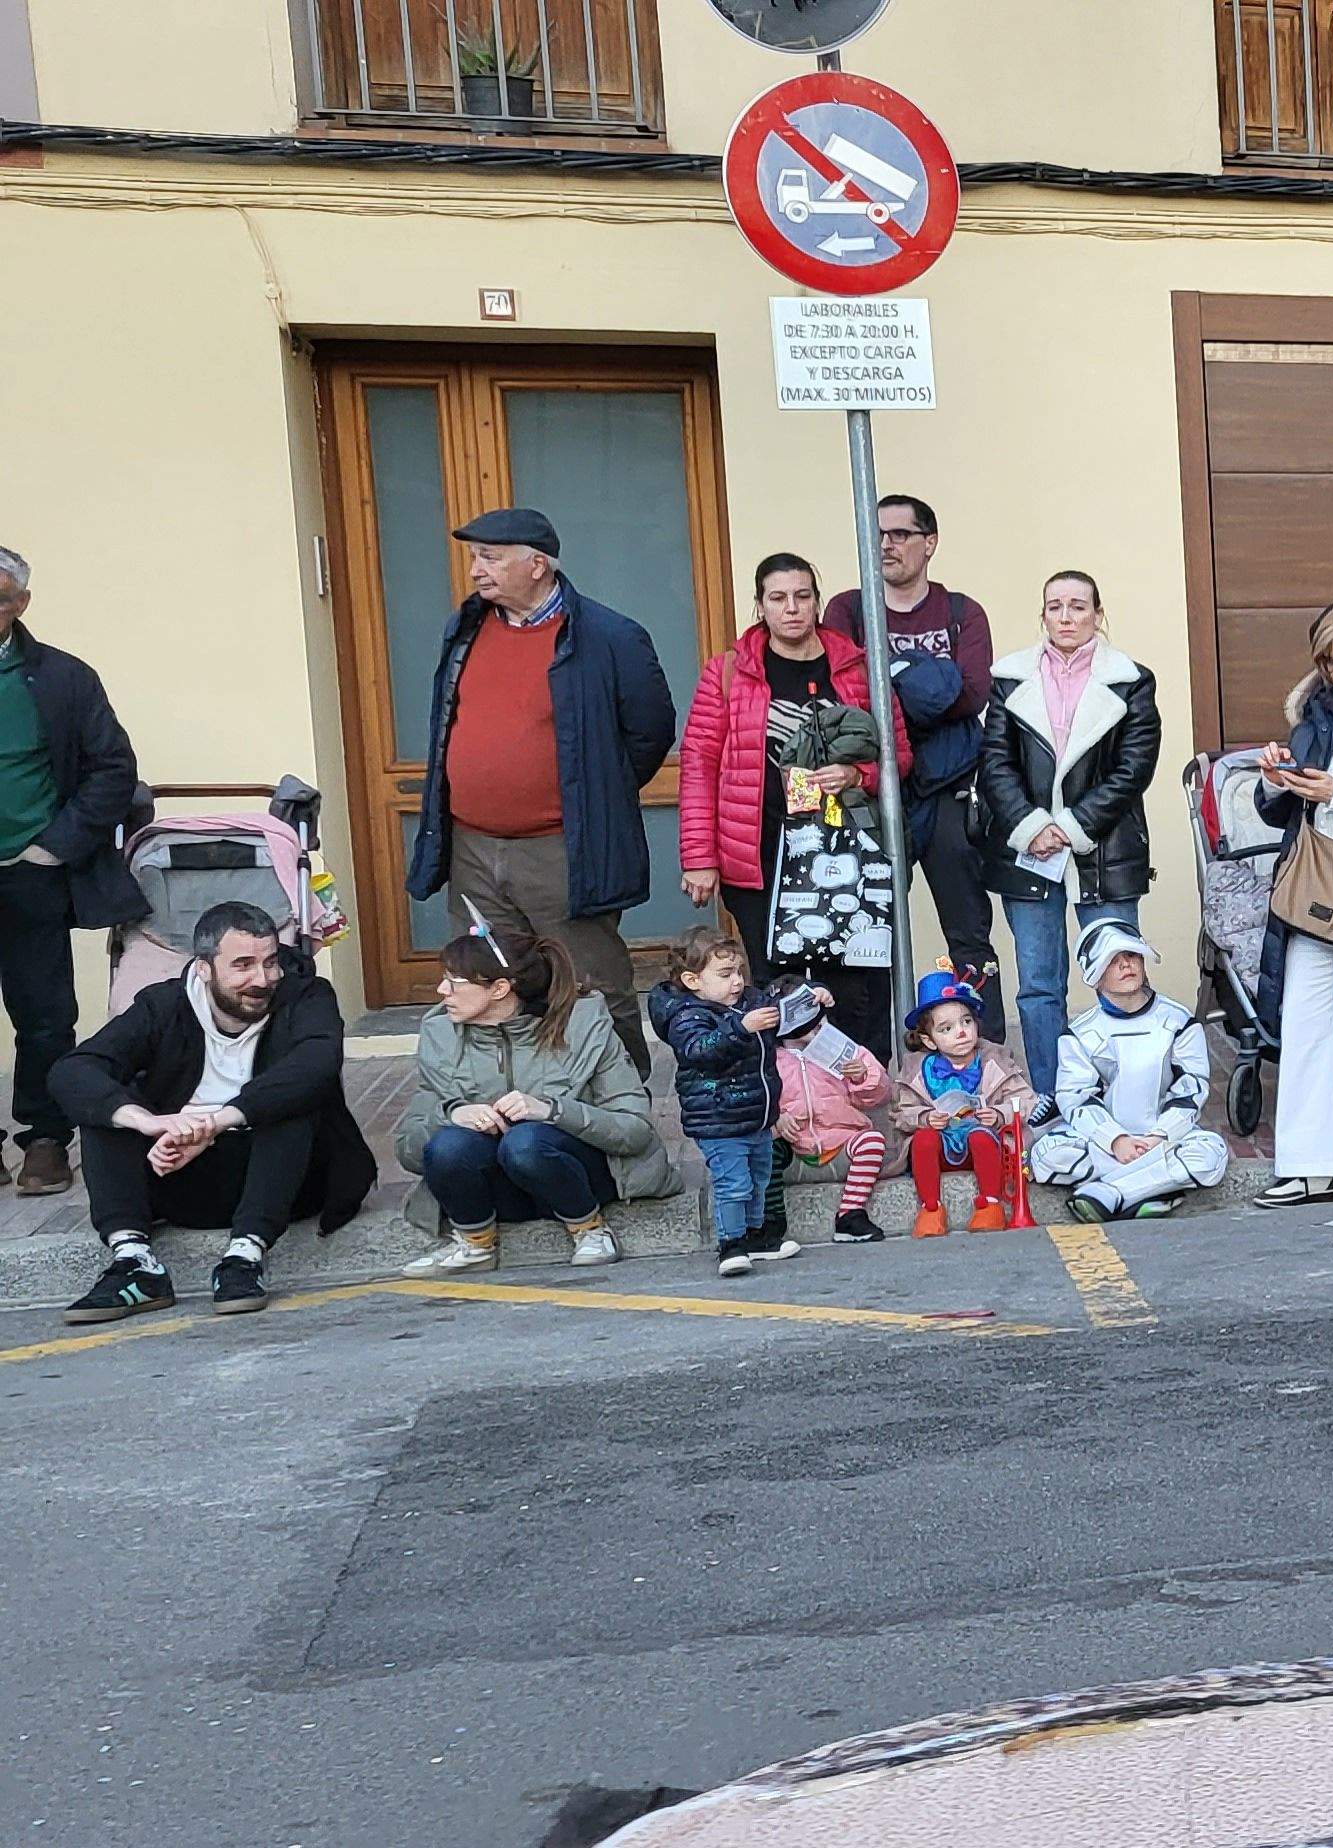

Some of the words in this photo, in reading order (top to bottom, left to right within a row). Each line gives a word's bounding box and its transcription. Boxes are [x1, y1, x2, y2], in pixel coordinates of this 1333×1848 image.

[799, 302, 900, 318] LABORABLES
[783, 323, 807, 339] DE
[844, 324, 858, 339] A
[860, 324, 900, 339] 20:00
[903, 324, 920, 339] H.
[789, 345, 861, 360] EXCEPTO
[863, 345, 918, 360] CARGA
[805, 365, 819, 381] Y
[820, 365, 906, 381] DESCARGA
[832, 387, 851, 402] 30
[854, 385, 933, 404] MINUTOS)
